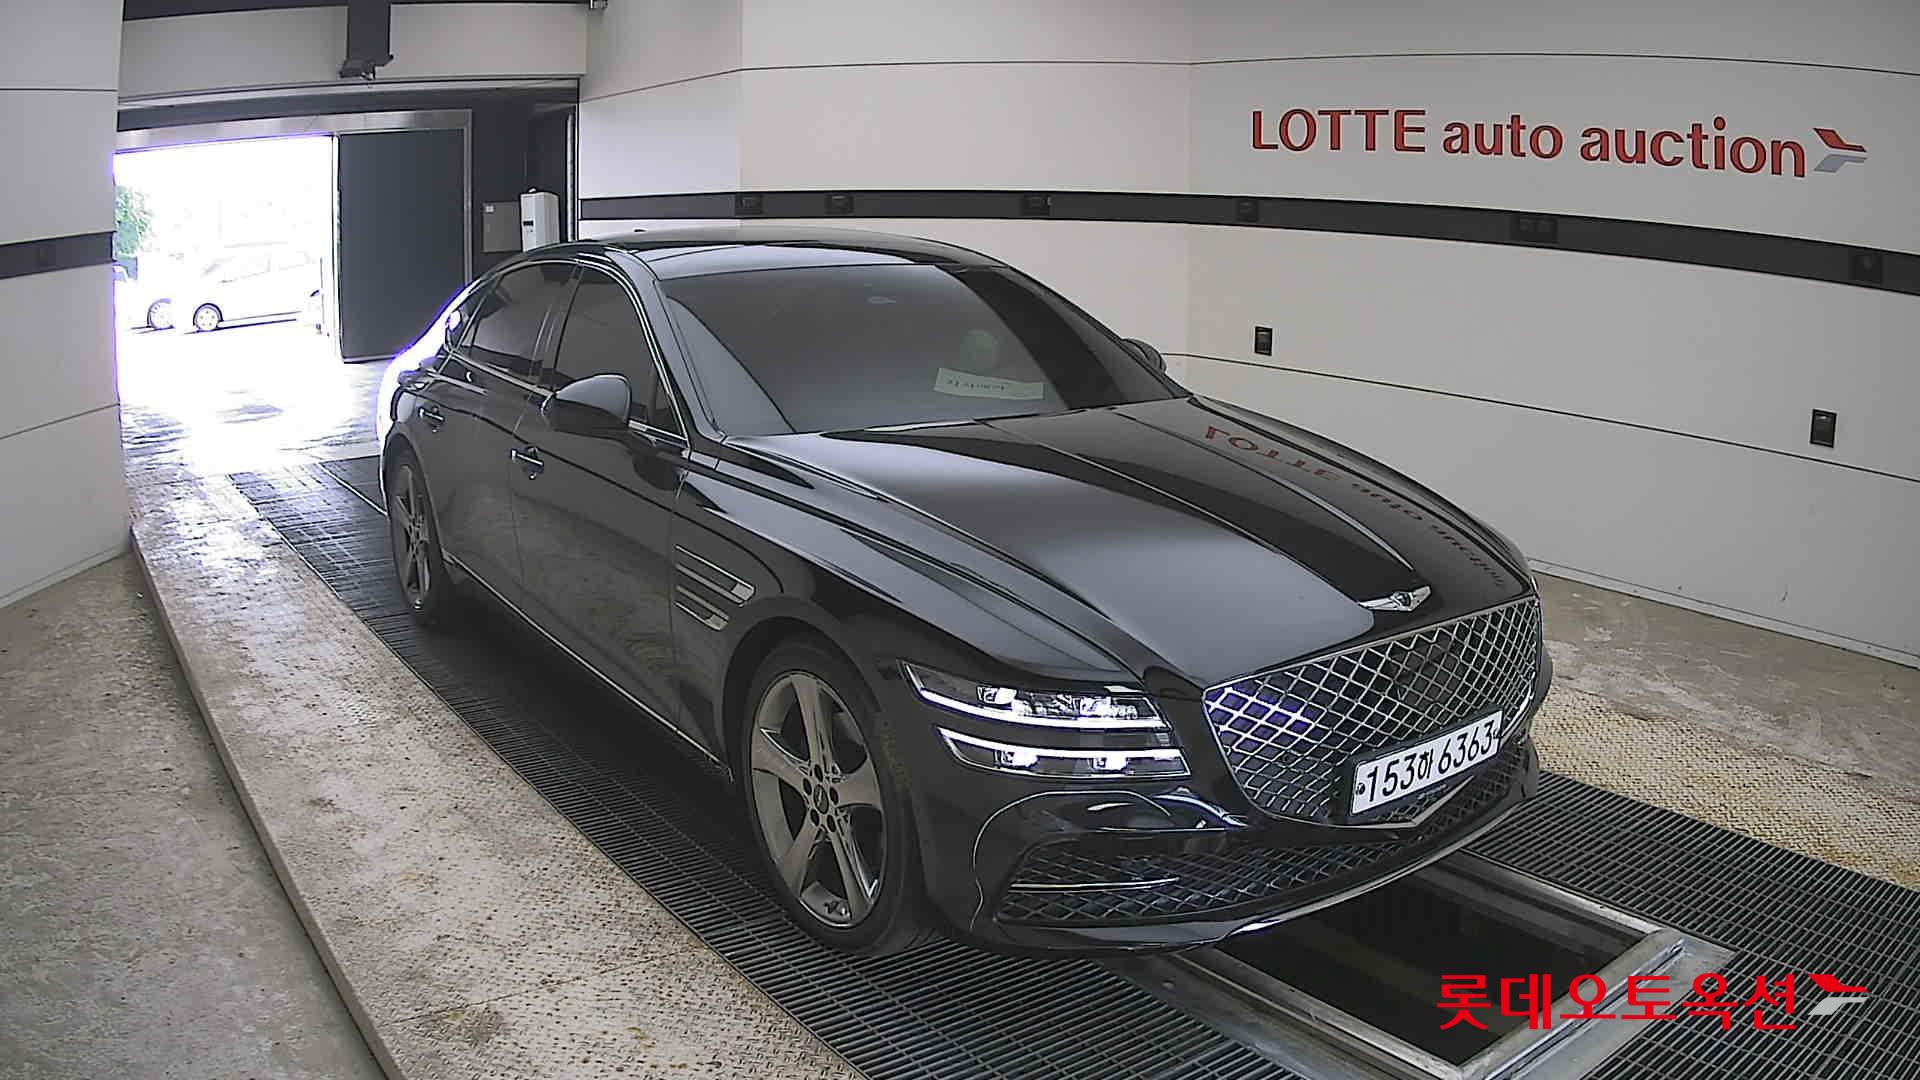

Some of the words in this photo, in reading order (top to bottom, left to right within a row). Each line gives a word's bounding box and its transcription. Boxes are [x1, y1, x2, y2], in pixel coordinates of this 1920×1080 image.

[1251, 108, 1426, 153] LOTTE
[1442, 113, 1563, 159] auto
[1579, 116, 1806, 178] auction
[1437, 719, 1495, 775] 6363
